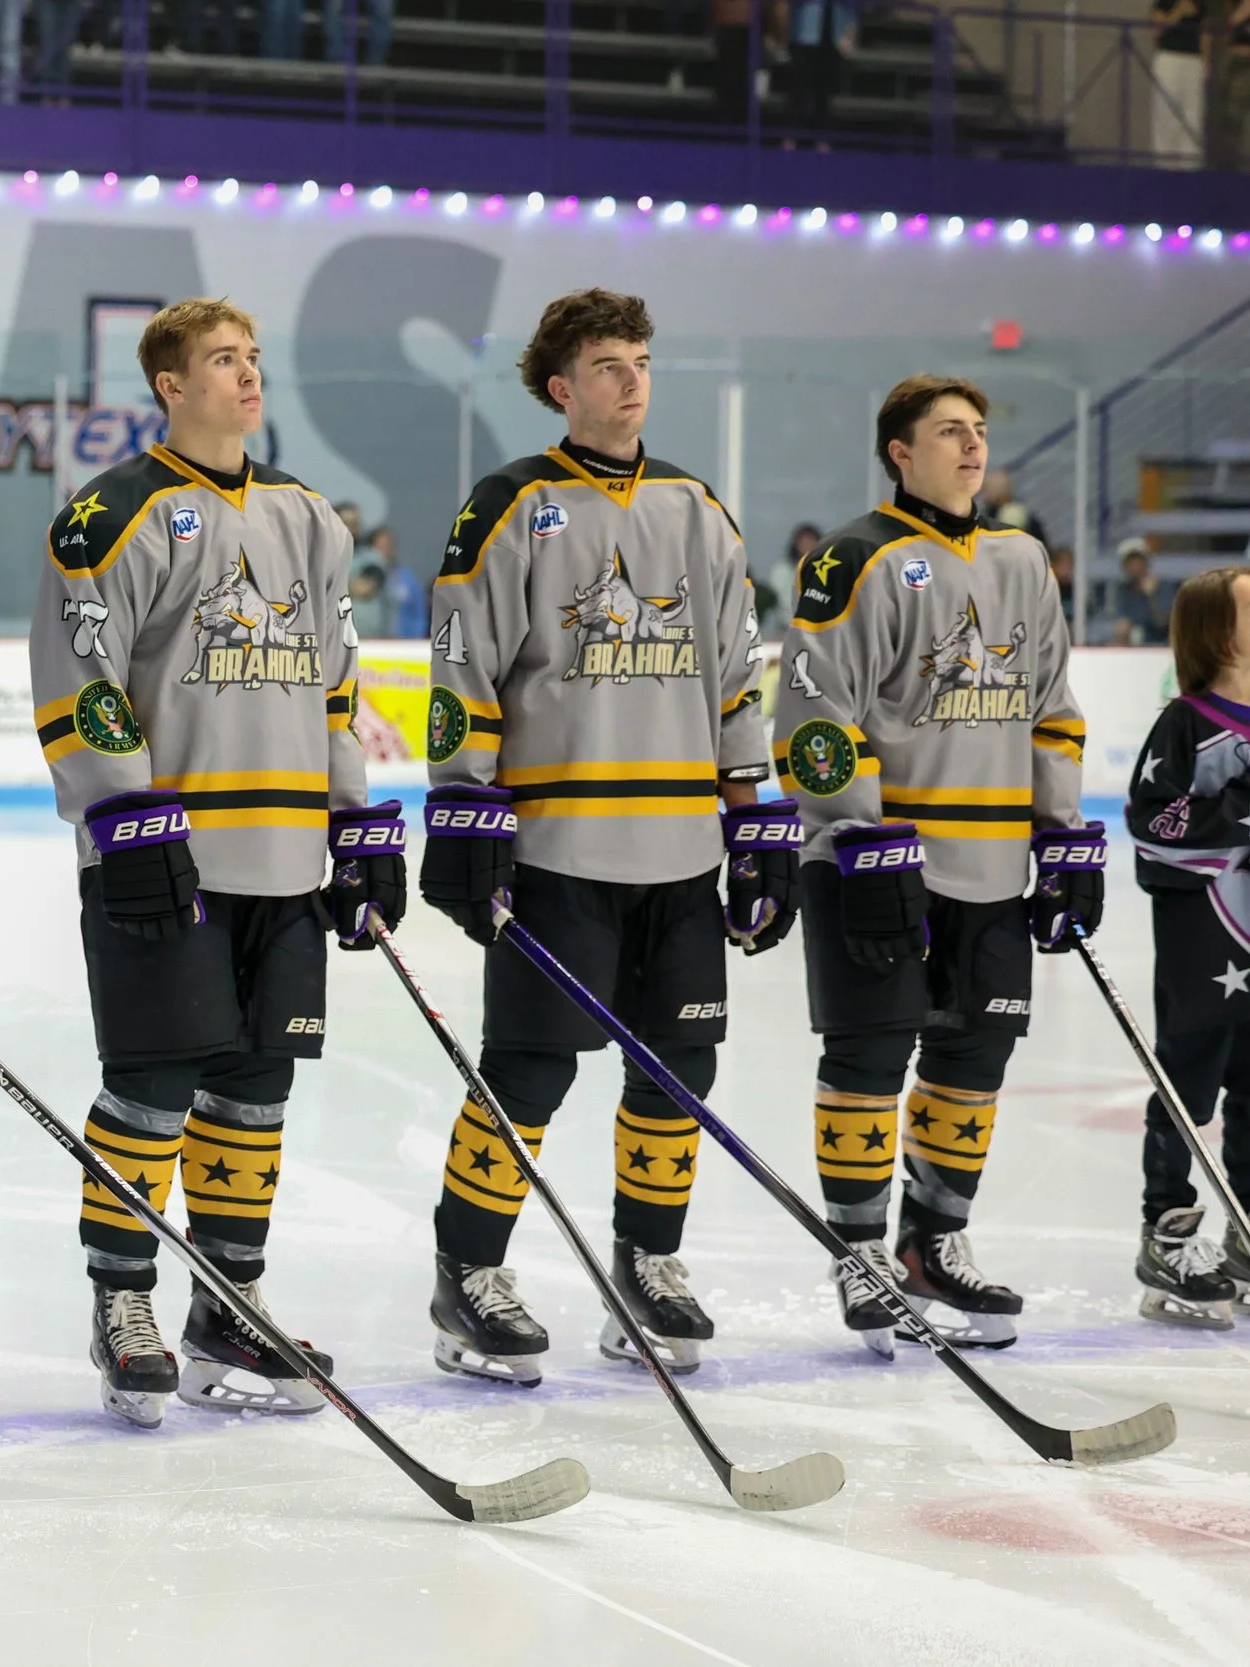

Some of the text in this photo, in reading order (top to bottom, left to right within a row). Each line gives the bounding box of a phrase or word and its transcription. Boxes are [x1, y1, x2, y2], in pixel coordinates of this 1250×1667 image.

[172, 513, 200, 536] NAHL
[532, 510, 565, 531] NAHL
[8, 1084, 75, 1151] BAUER
[656, 1071, 727, 1142] HYPRLITE
[836, 1254, 946, 1356] BAUER
